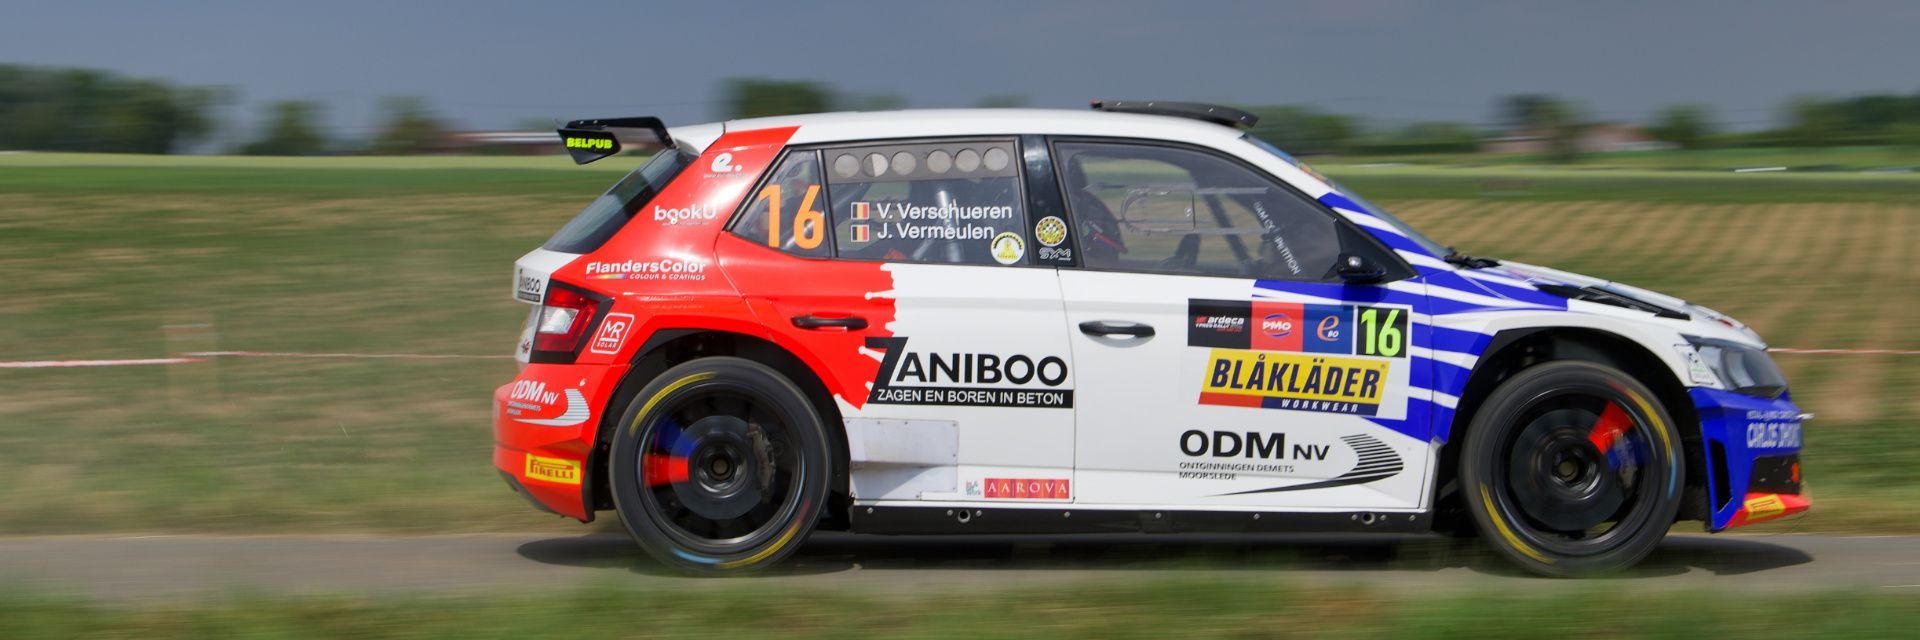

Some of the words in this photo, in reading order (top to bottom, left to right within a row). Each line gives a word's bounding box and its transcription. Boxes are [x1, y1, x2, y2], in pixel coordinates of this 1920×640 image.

[566, 137, 613, 150] BELPUB
[759, 184, 825, 250] 16
[877, 203, 893, 219] V.
[897, 202, 1012, 220] Verschueren
[877, 224, 892, 239] J.
[896, 222, 995, 239] Vermeulen
[586, 259, 706, 275] FlandersColor
[601, 320, 625, 338] MR
[1361, 309, 1403, 357] 16
[865, 336, 1068, 391] ZANIBOO
[1210, 353, 1380, 399] BLÅKLÄDER
[511, 379, 546, 402] ODM
[541, 391, 560, 406] NV
[877, 389, 922, 402] ZAGEN
[925, 389, 944, 403] EN
[948, 390, 996, 404] BOREN
[1000, 391, 1013, 404] IN
[1017, 392, 1064, 405] BETON
[1281, 398, 1359, 413] WORKWEAR
[1179, 429, 1285, 460] ODM
[1293, 444, 1330, 460] NV
[530, 459, 574, 480] PIRELLI
[1179, 462, 1255, 472] ONTGINNINGEN
[1256, 463, 1294, 473] DEMETS
[1179, 471, 1237, 480] MOORSLEDE
[988, 481, 1067, 494] AAROVA
